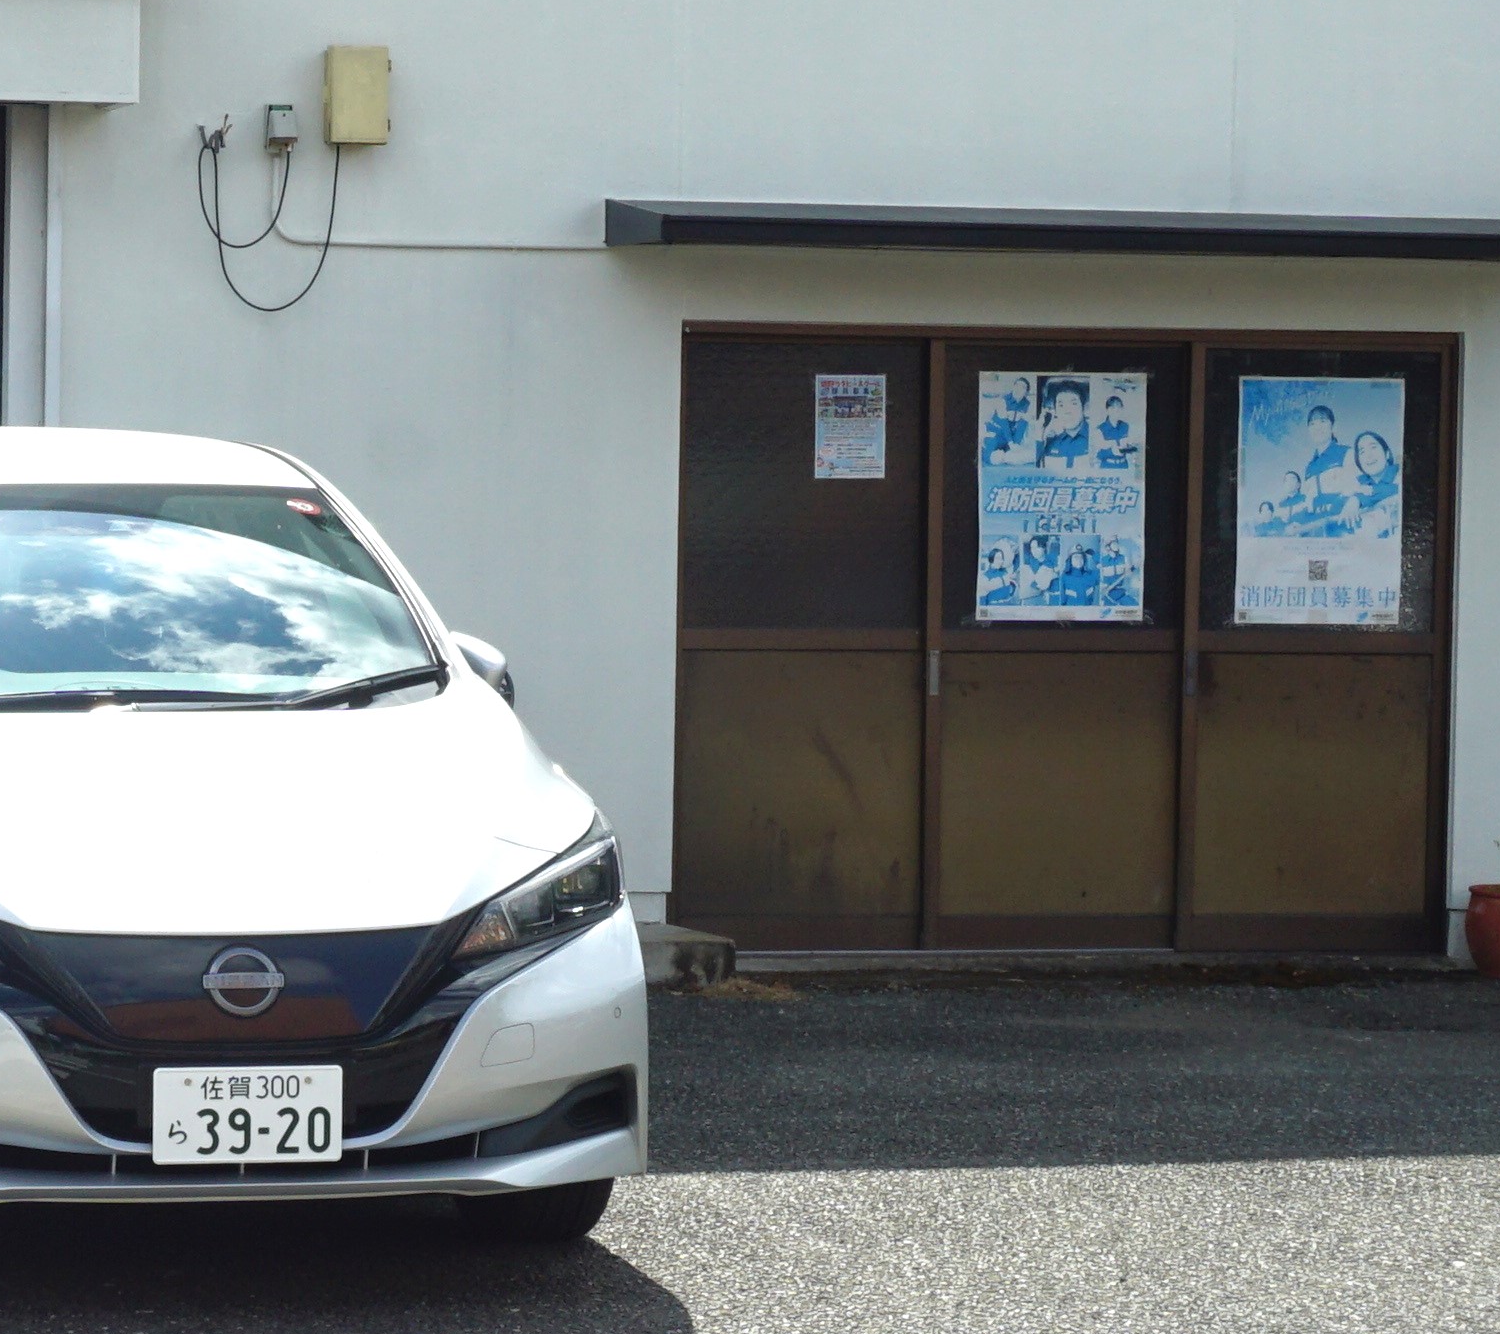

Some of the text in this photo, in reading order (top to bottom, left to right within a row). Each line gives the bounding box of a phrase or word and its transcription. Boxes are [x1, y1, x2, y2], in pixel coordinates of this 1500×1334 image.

[986, 486, 1140, 514] 消防団員募集中
[1240, 585, 1396, 608] 消防団員募集中
[168, 1106, 331, 1155] ら 39-20
